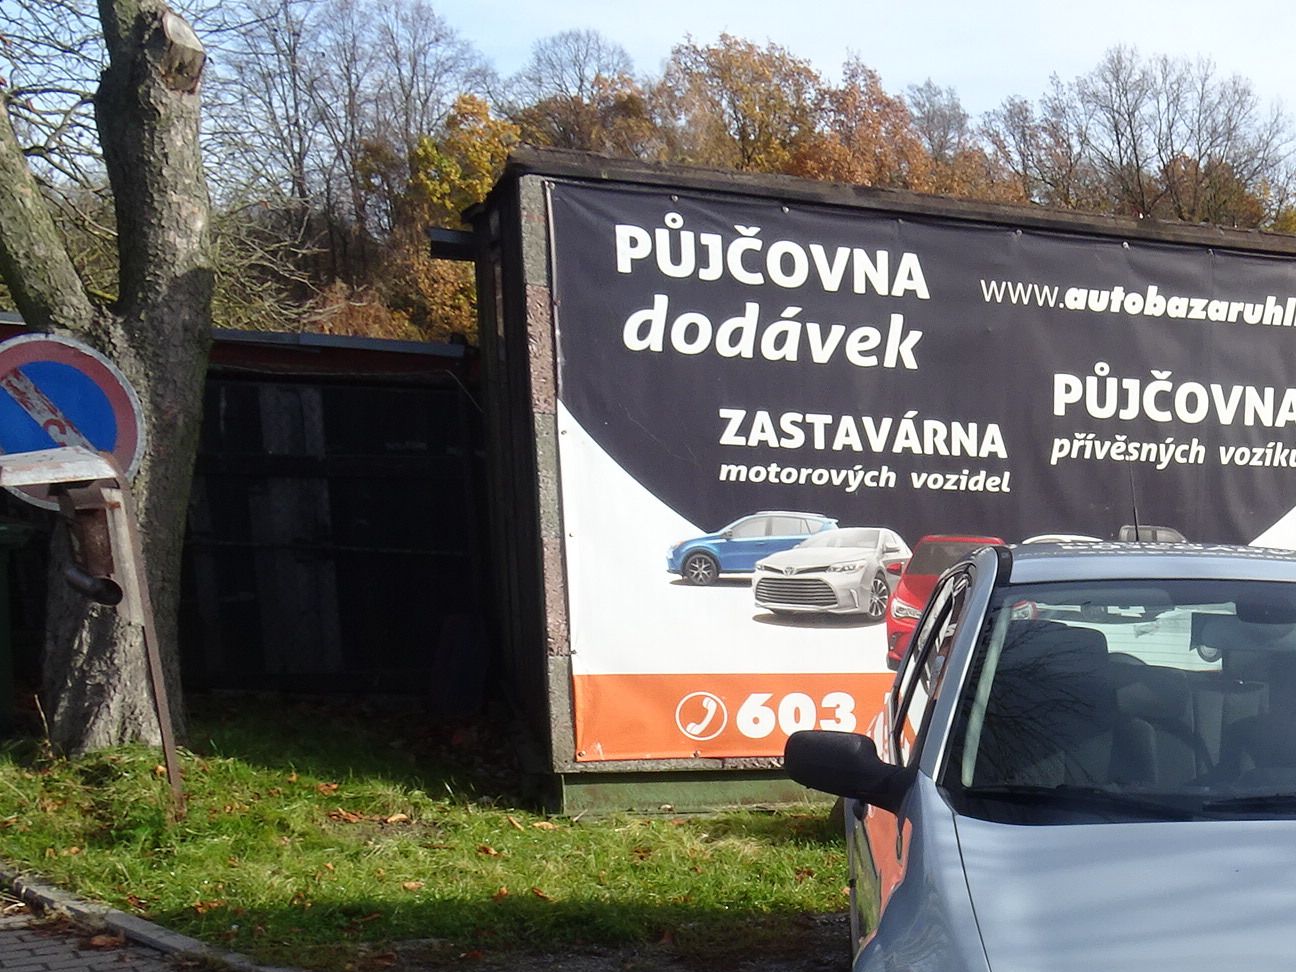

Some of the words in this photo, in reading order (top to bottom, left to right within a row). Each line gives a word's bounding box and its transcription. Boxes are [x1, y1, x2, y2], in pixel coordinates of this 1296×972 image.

[614, 212, 931, 300] PŮJČOVNA
[622, 294, 924, 370] dodávek
[718, 408, 1009, 459] ZASTAVÁRNA
[1050, 431, 1206, 470] přívěsných
[718, 462, 897, 493] motorových
[910, 468, 1011, 494] vozidel
[735, 692, 857, 738] 603
